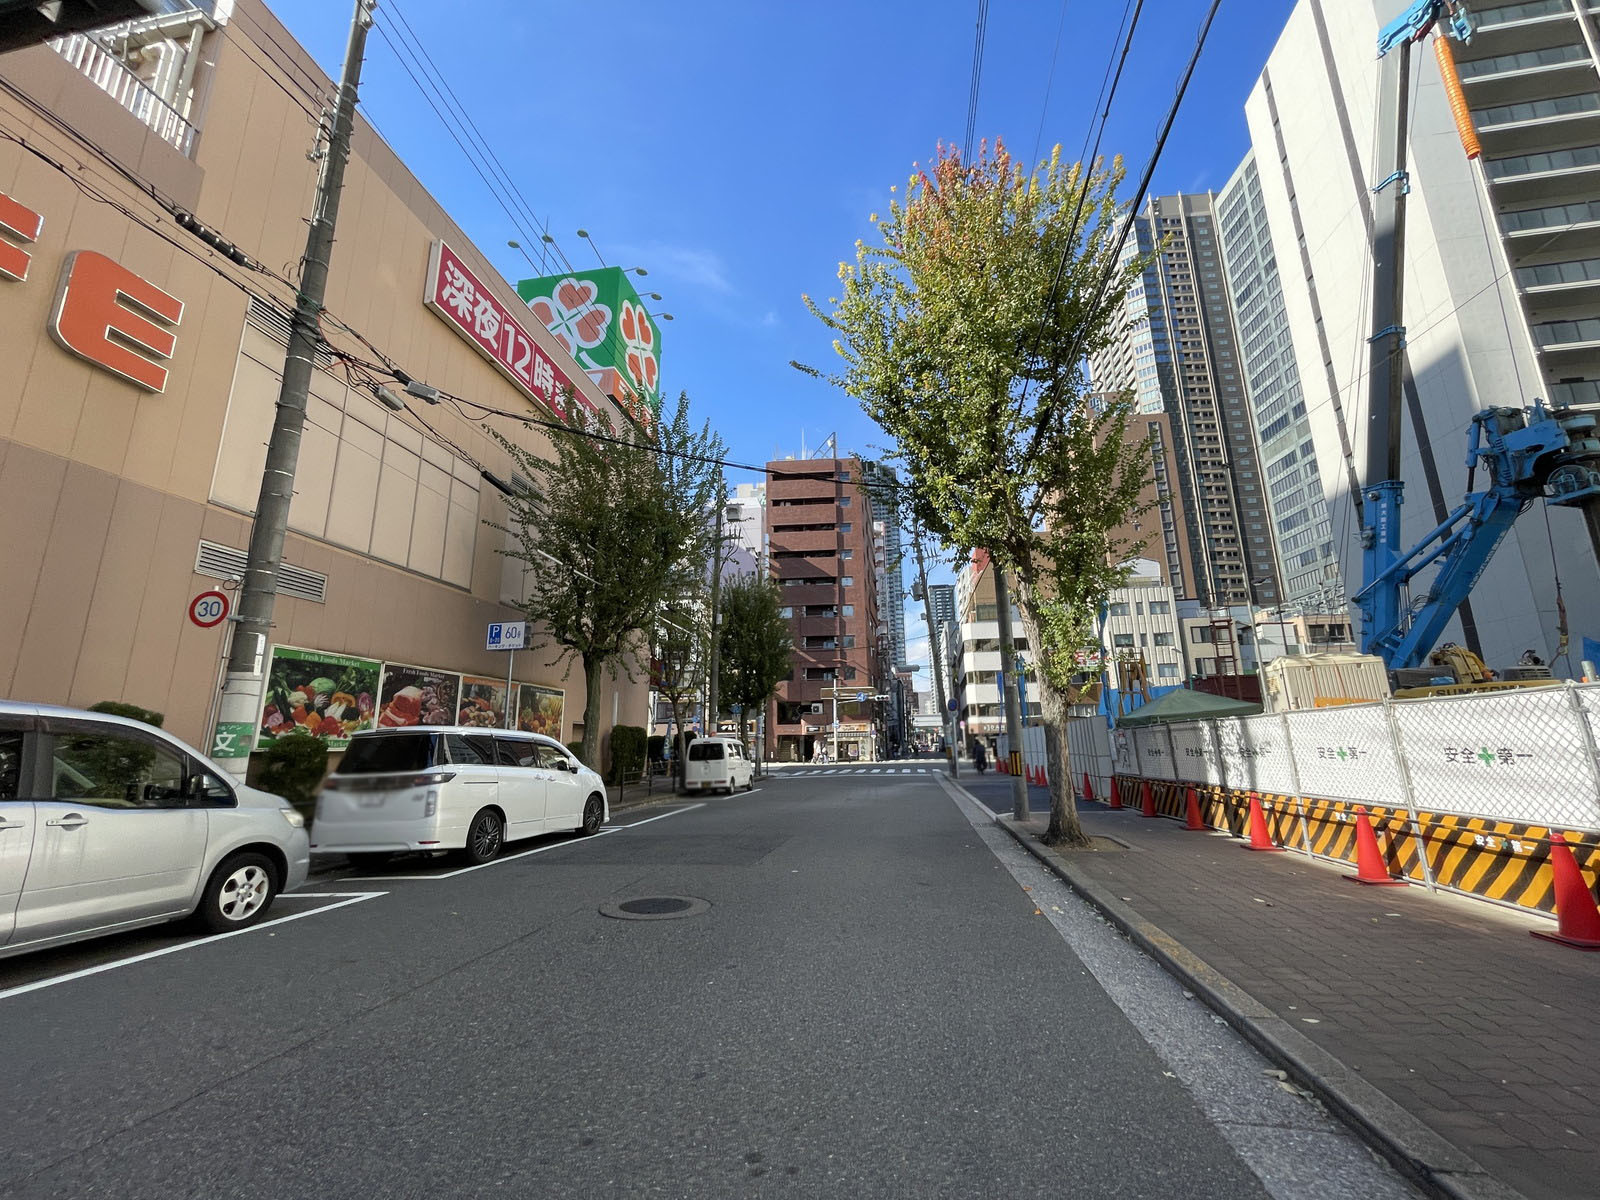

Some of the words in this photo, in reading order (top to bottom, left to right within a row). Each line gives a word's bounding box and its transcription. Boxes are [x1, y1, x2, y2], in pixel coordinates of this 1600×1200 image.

[198, 601, 220, 617] 30
[301, 653, 319, 661] Fresh
[320, 656, 338, 664] Foods
[340, 659, 361, 667] Market
